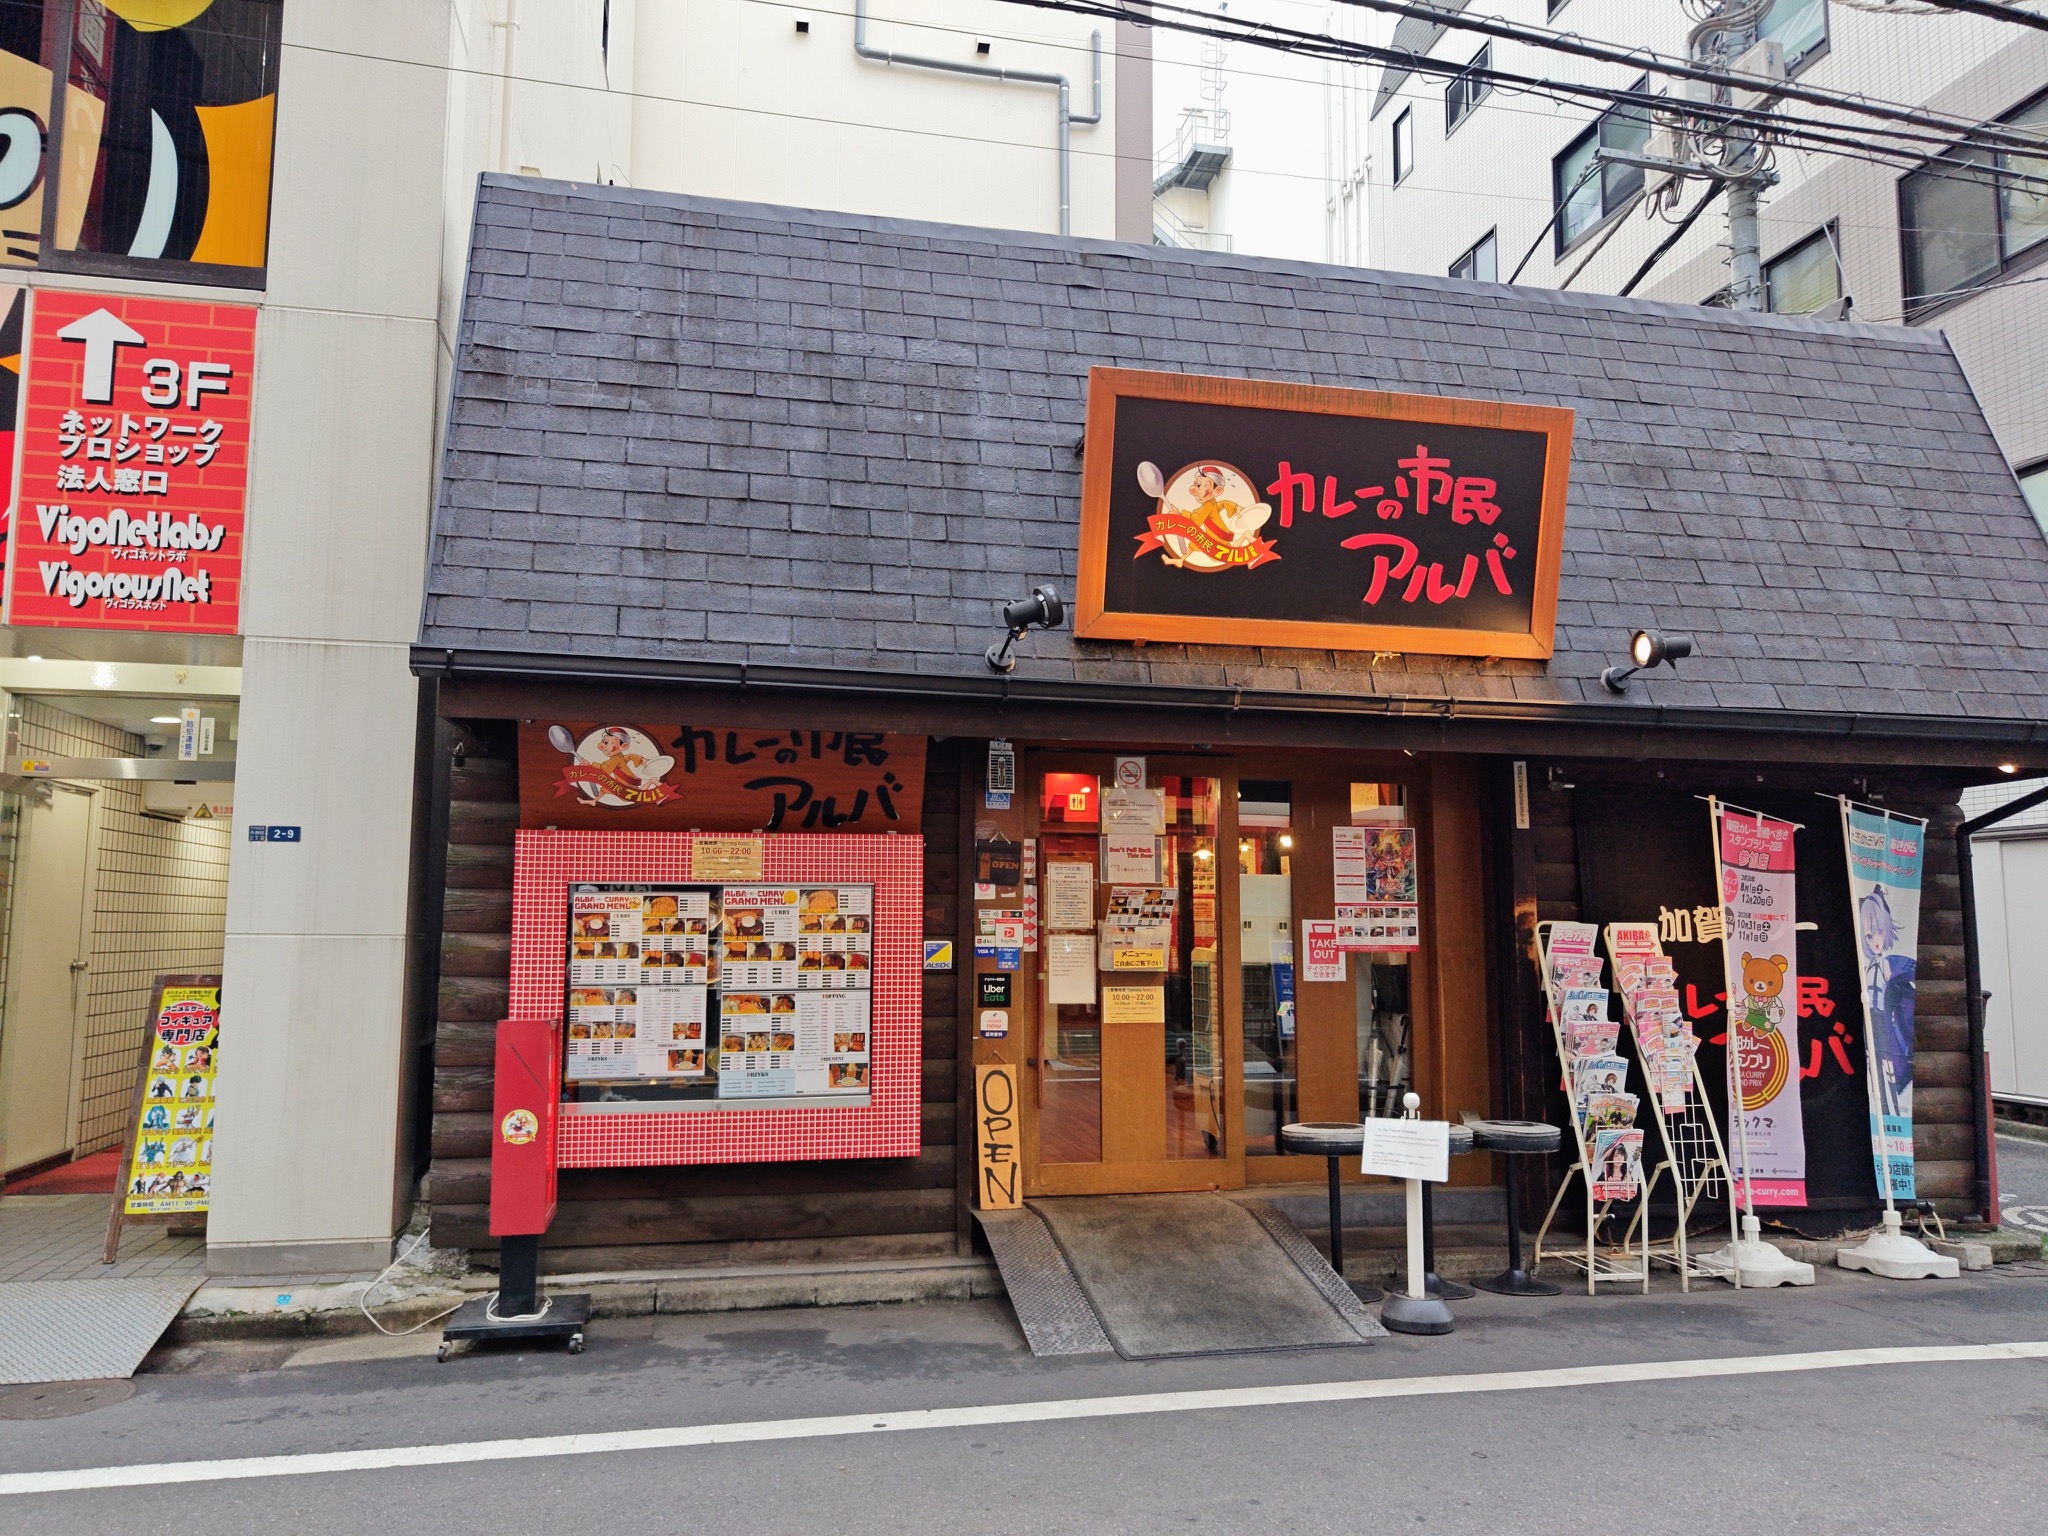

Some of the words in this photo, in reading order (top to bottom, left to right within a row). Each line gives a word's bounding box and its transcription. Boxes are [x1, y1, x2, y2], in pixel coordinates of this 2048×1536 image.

[141, 358, 232, 408] 3F
[59, 410, 223, 443] ネットワーク
[58, 434, 221, 466] プロショップ
[56, 464, 169, 495] 法人窓口
[1266, 444, 1502, 528] カレーの市民
[35, 504, 225, 555] VigoNetlabs
[1154, 519, 1214, 554] カレーの市民
[1214, 543, 1260, 564] アルバ
[111, 547, 187, 562] ヴィゴネットラボ
[1341, 531, 1517, 606] アルバ
[38, 560, 211, 607] VigorousNet
[624, 787, 665, 802] アルバ
[743, 772, 903, 831] アルバ
[273, 829, 294, 839] 2-9
[992, 861, 1020, 869] OPEN
[1738, 849, 1770, 870] 参加店
[574, 902, 606, 910] GRAND
[724, 897, 758, 906] GRAND
[1553, 928, 1594, 942] あきかる
[1616, 929, 1645, 941] AKIBA
[1310, 938, 1337, 948] TAKE
[1313, 949, 1335, 959] OUT
[1557, 957, 1582, 967] あきかる
[1312, 971, 1337, 979] できます
[983, 984, 1006, 993] Uber
[984, 993, 1005, 1002] Eats
[160, 1015, 212, 1026] フィギュア
[160, 1028, 206, 1042] 専門店
[1574, 1025, 1599, 1034] あきかる
[1749, 1078, 1763, 1087] PRIX
[982, 1069, 1016, 1205] OPEN
[136, 1161, 162, 1169] EVA
